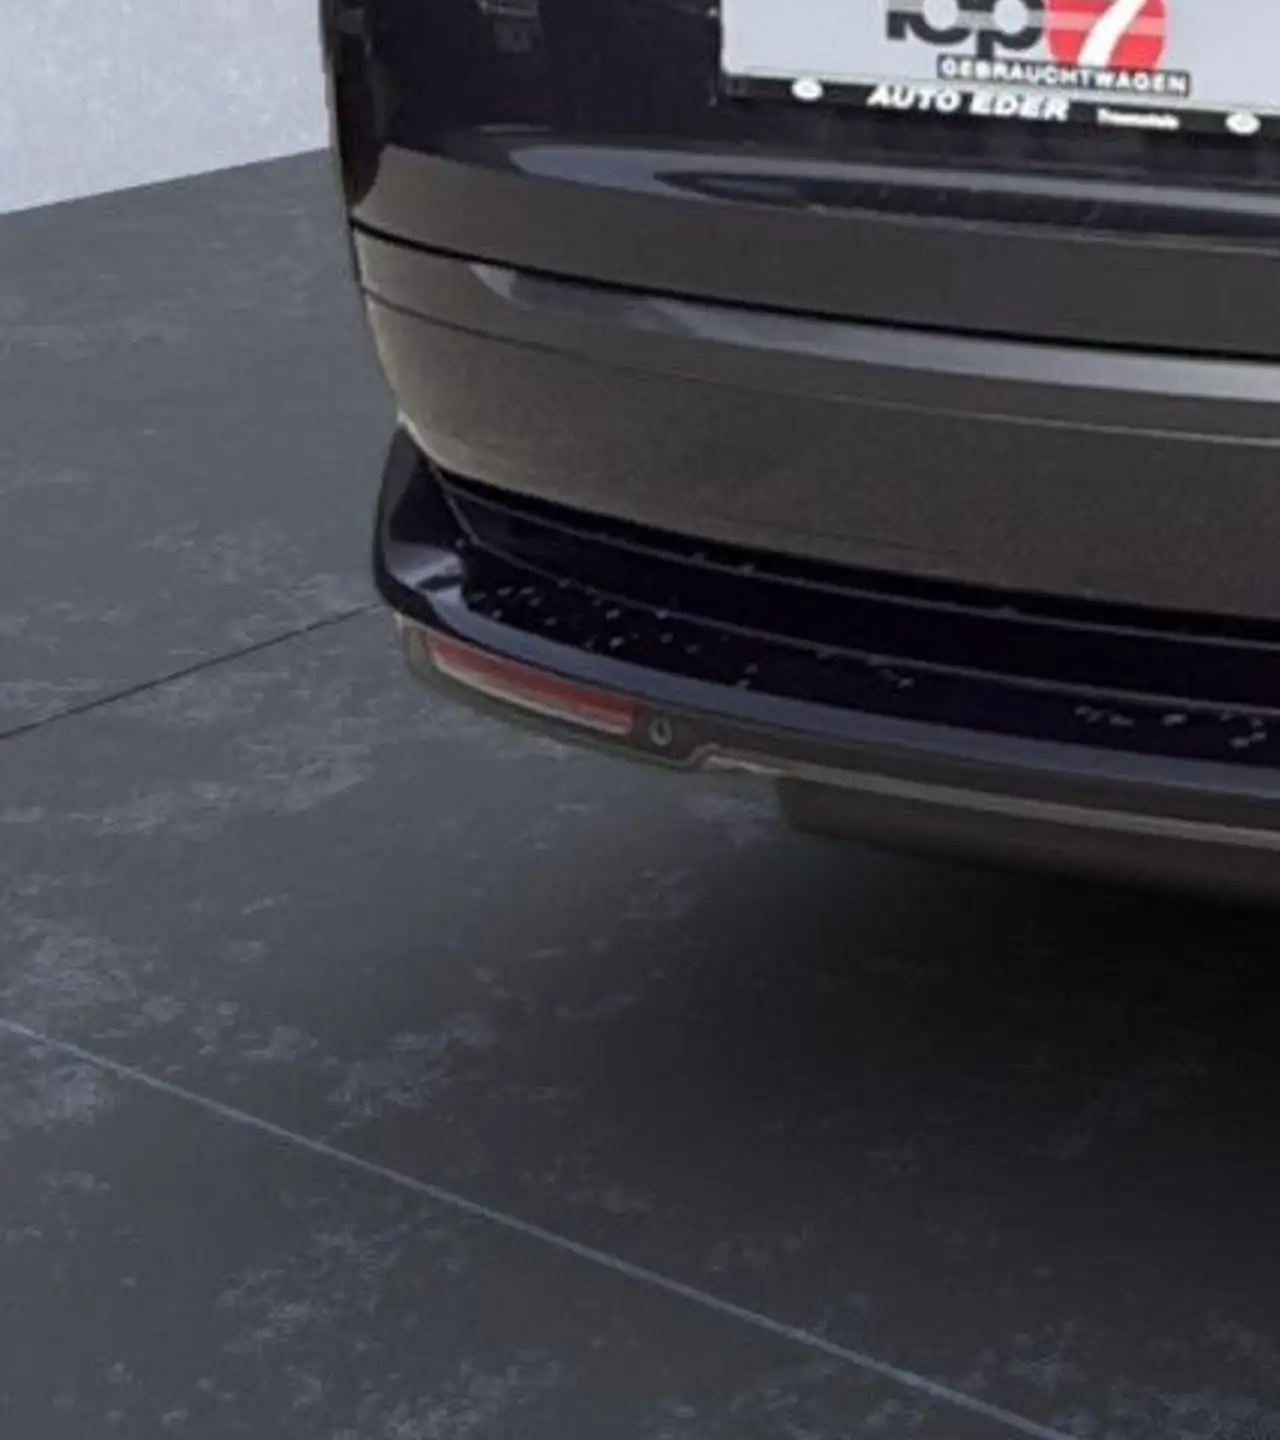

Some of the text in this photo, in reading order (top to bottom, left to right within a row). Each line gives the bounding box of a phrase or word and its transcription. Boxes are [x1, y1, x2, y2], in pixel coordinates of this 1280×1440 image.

[940, 56, 1188, 95] GEBRAUCHTWAGEN
[866, 83, 962, 111] AUTO
[969, 92, 1071, 122] EDER
